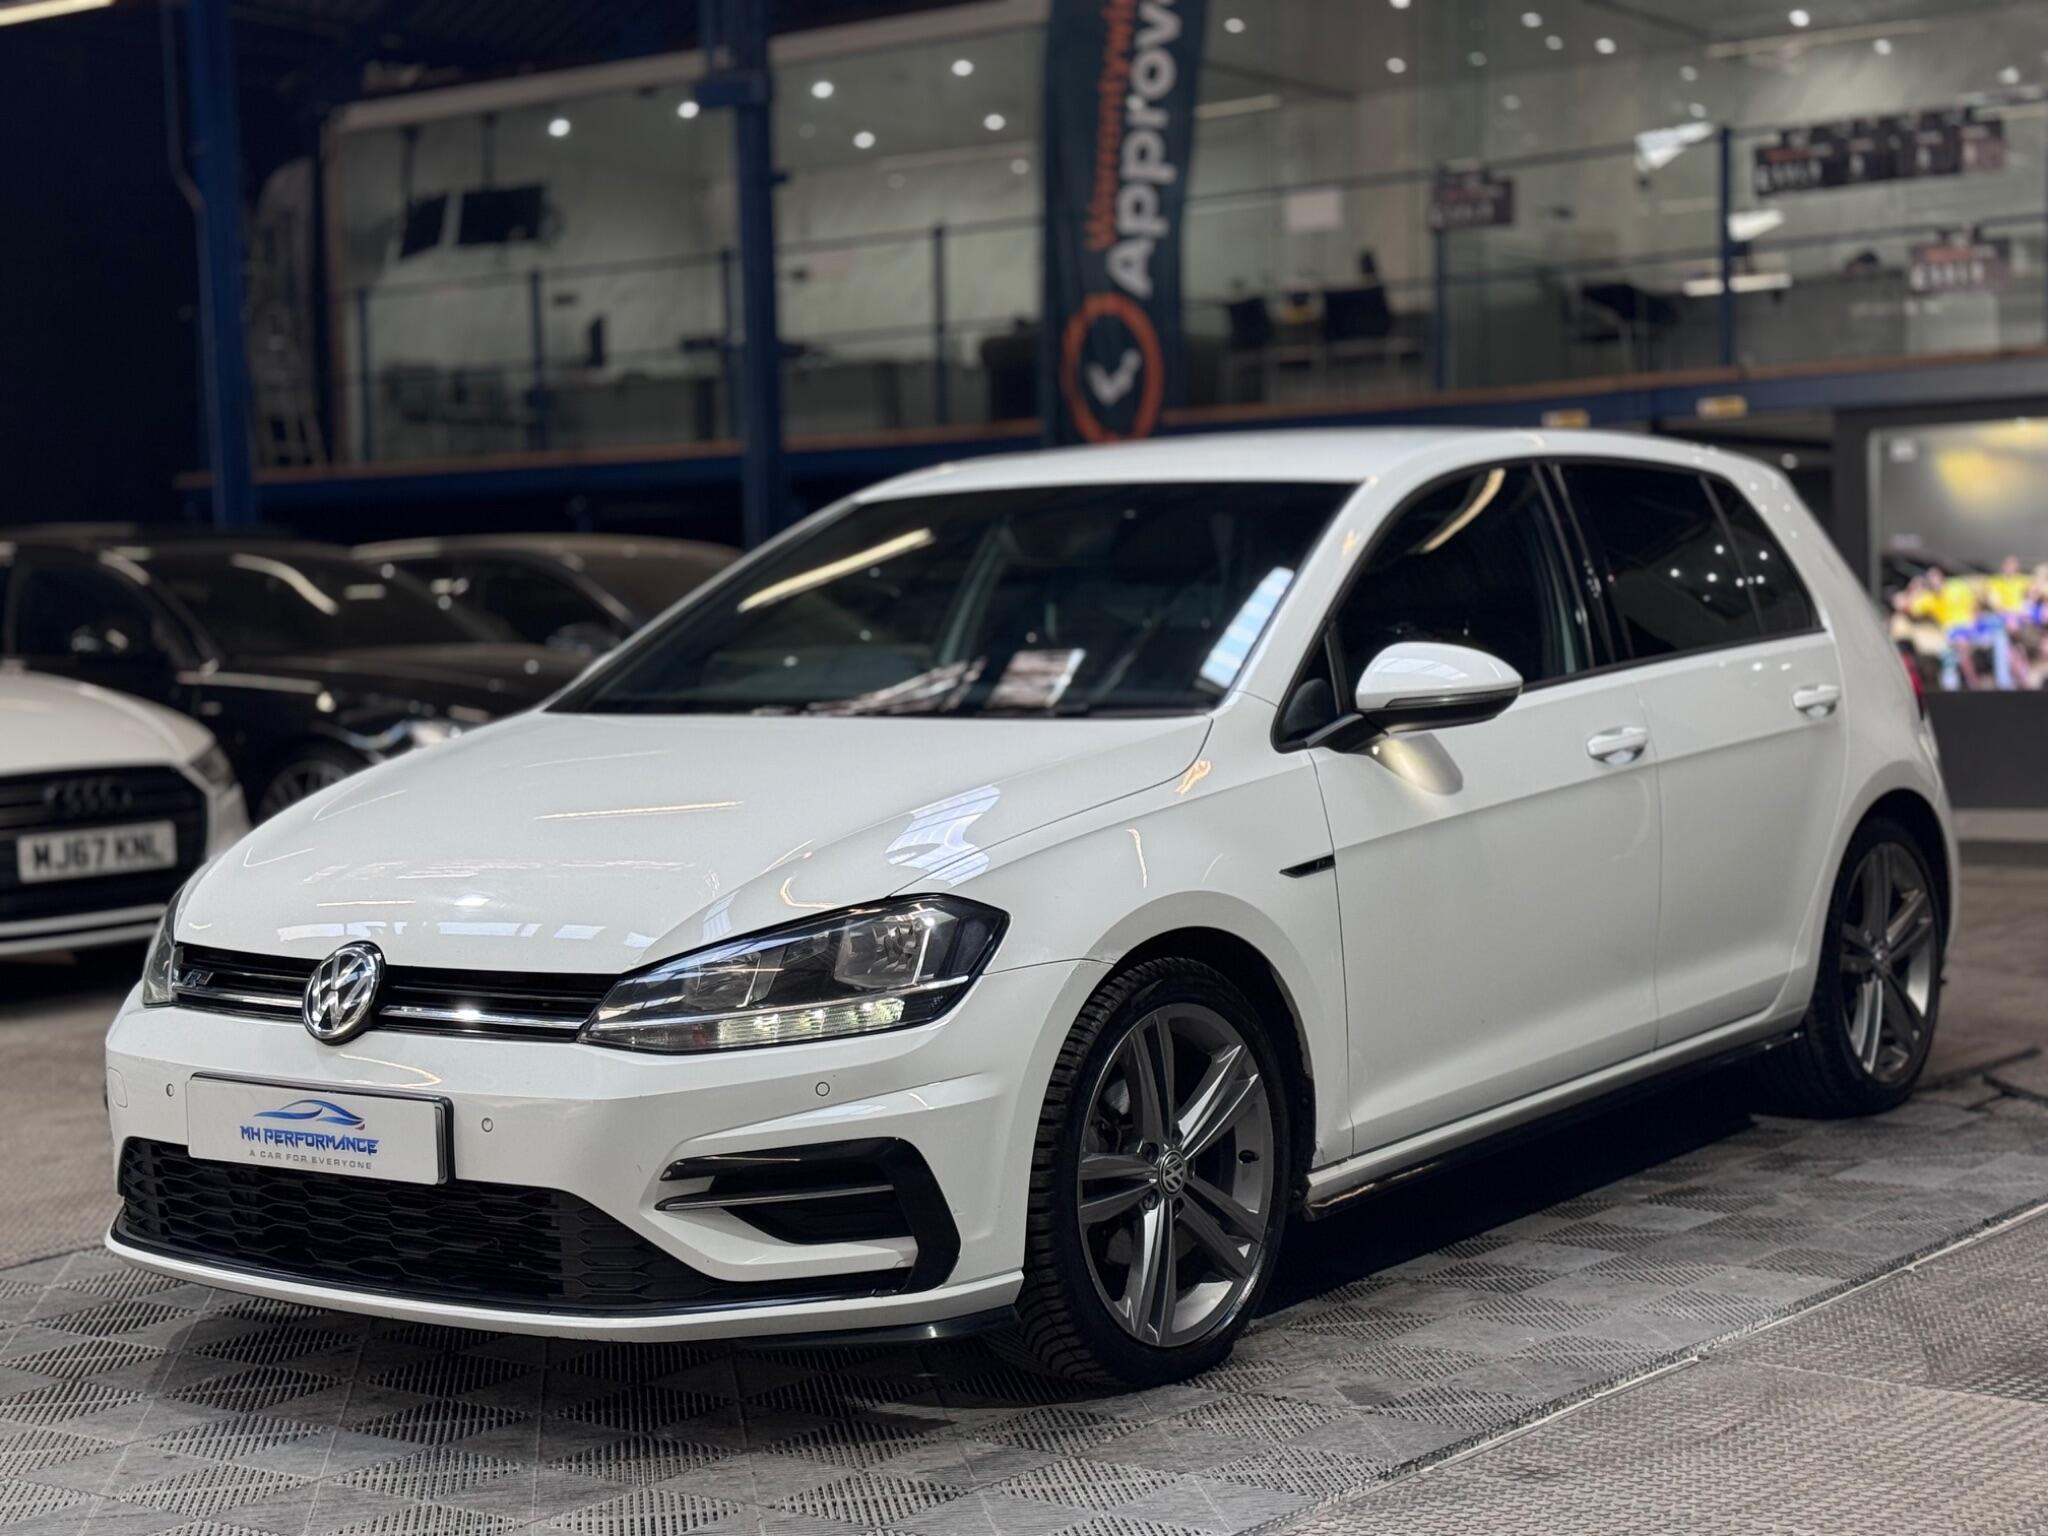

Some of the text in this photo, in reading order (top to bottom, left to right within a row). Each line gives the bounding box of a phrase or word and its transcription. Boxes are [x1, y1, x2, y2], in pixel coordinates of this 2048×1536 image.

[240, 1125, 379, 1155] MH PERFORMANCE
[249, 1149, 372, 1170] A CAR FOR EVERYONE
